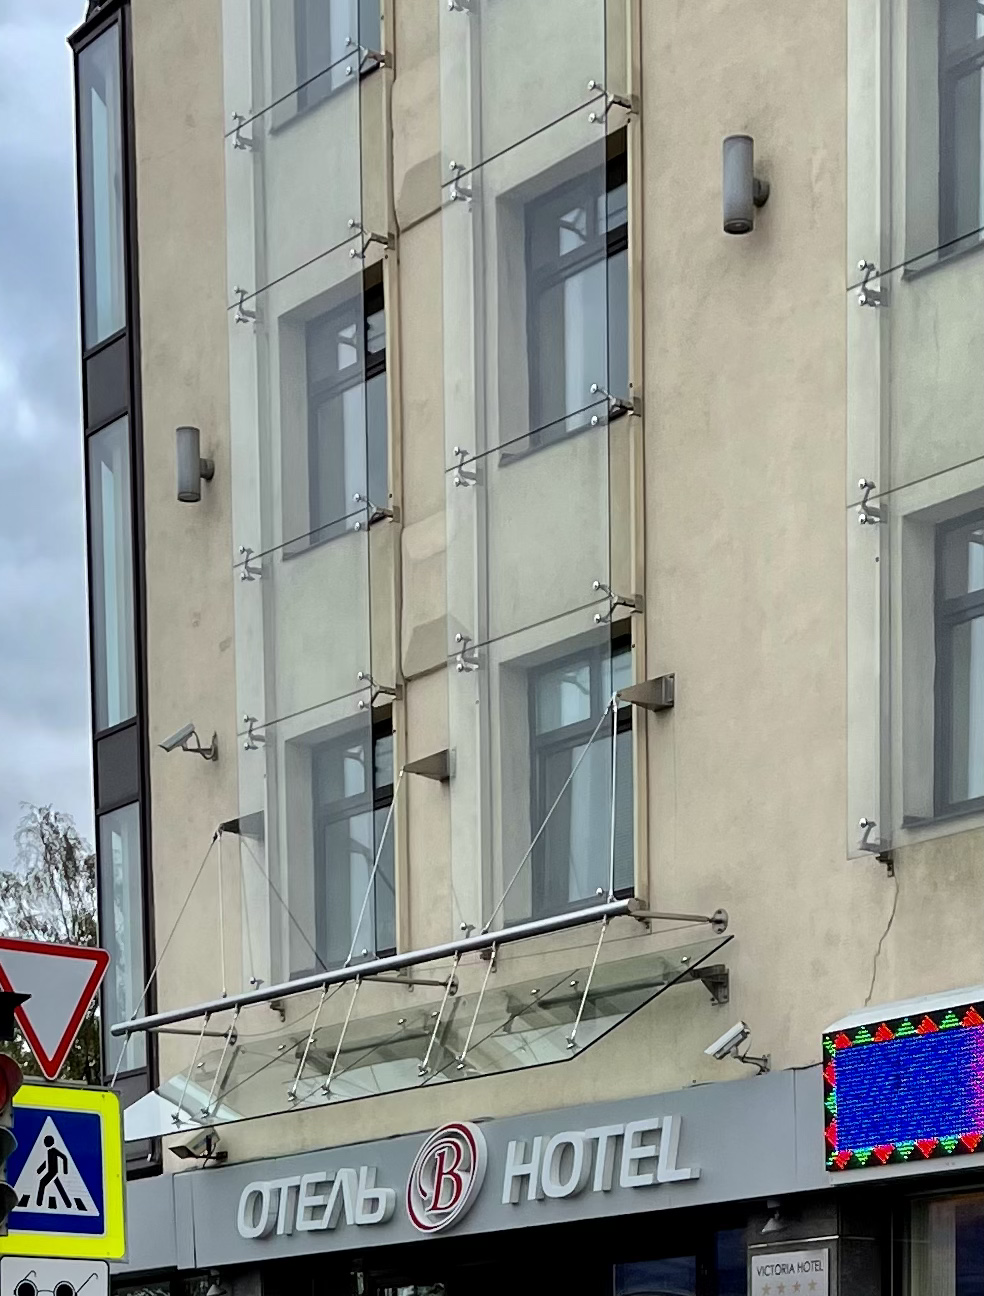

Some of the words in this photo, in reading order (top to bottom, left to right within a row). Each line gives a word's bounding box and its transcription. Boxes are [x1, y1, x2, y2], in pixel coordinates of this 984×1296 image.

[502, 1115, 701, 1205] HOTEL
[237, 1166, 397, 1239] ОТЕЛЬ
[756, 1262, 796, 1277] VICTORIA
[797, 1259, 824, 1274] HOTEL
